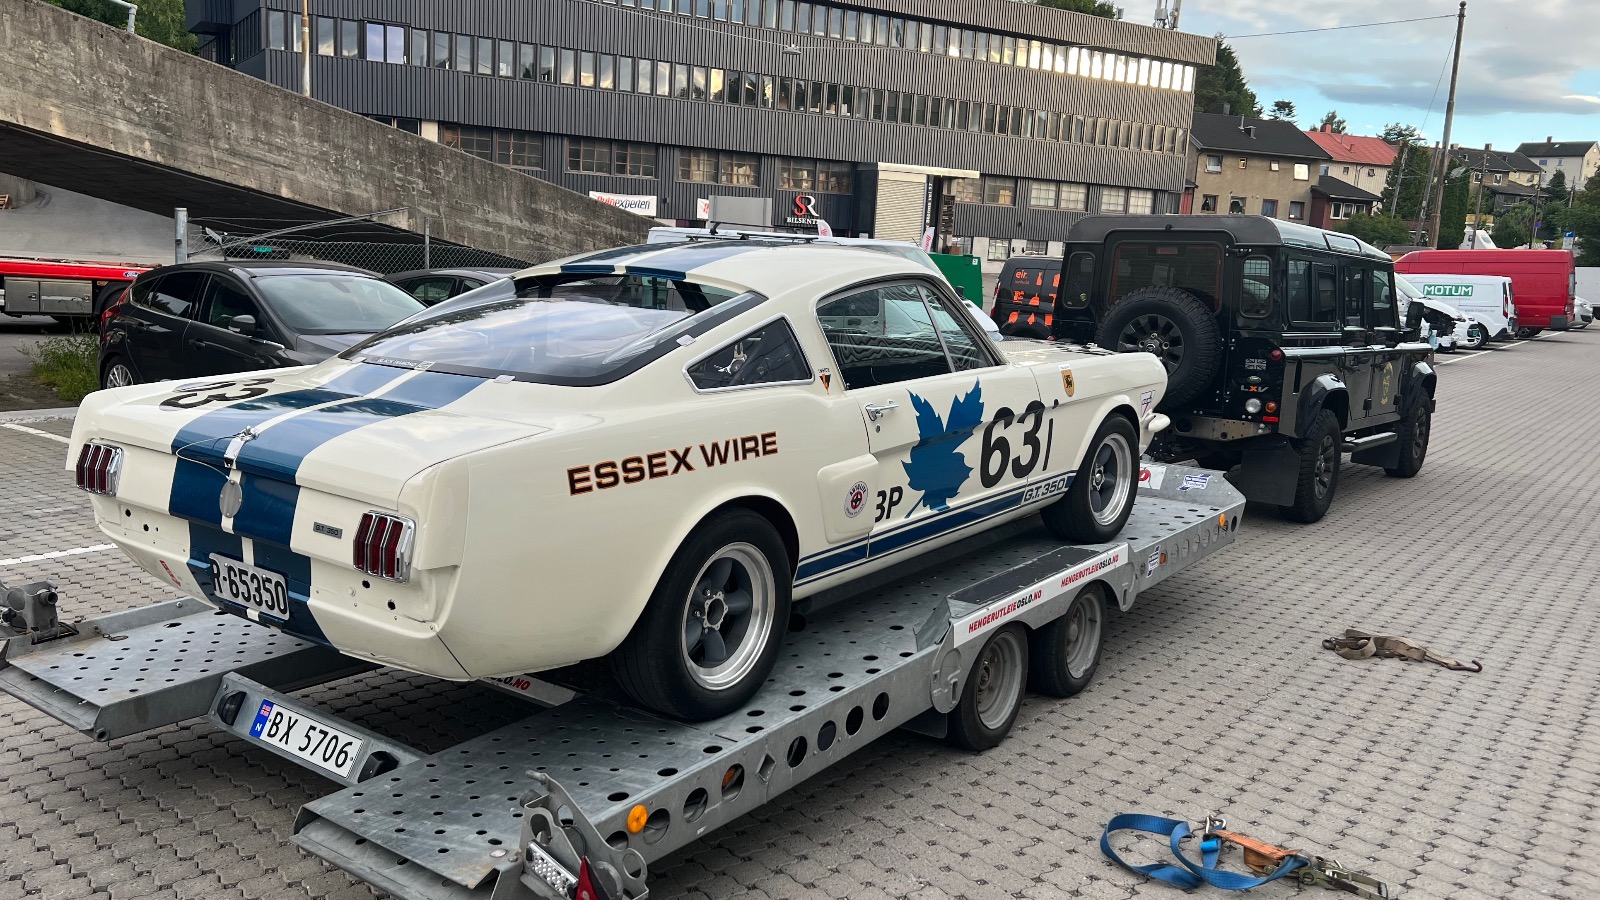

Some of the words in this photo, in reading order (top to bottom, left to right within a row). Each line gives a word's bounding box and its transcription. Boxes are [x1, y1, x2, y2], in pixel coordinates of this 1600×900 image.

[1424, 285, 1472, 296] MOTUM
[566, 446, 696, 496] ESSEX
[699, 431, 779, 468] WIRE
[210, 559, 288, 615] R-65350
[254, 722, 263, 732] N
[266, 711, 299, 745] BX
[298, 724, 353, 768] 5706
